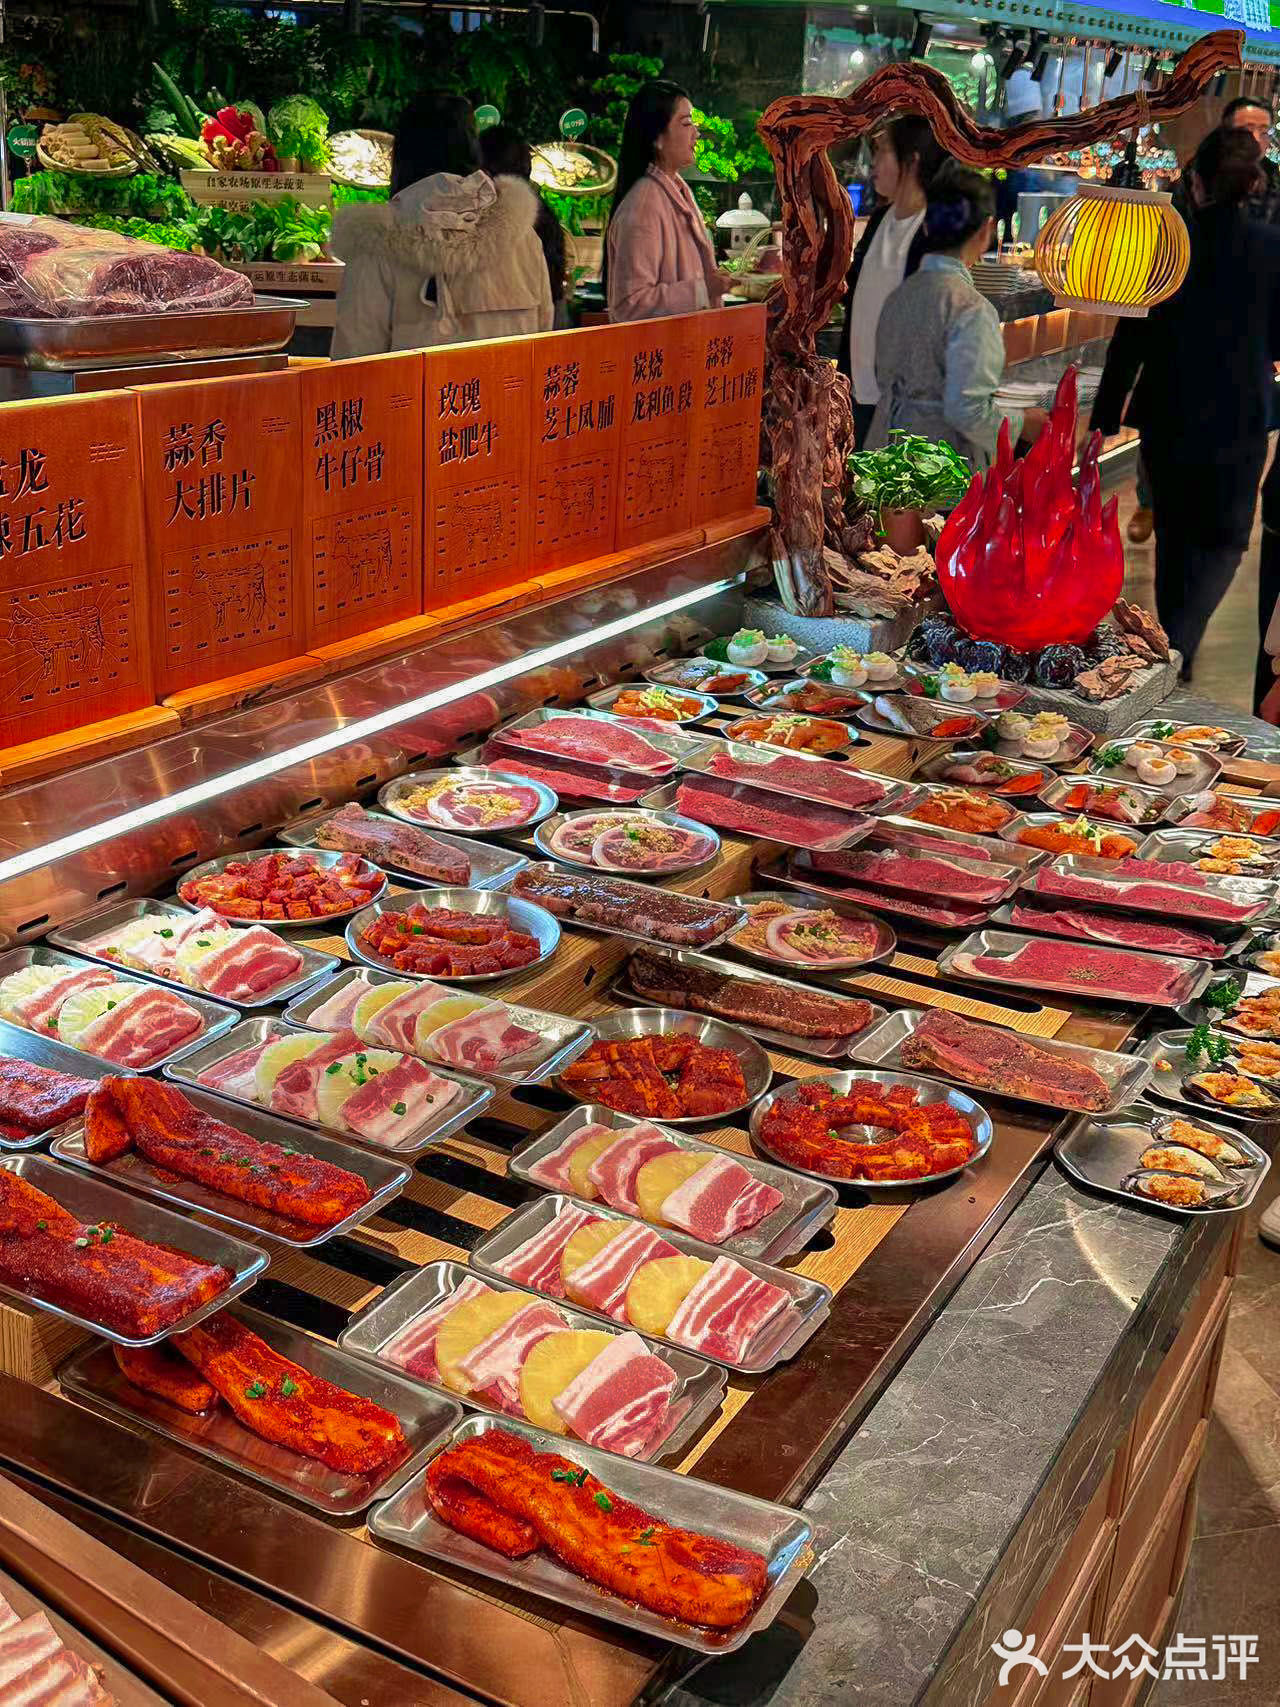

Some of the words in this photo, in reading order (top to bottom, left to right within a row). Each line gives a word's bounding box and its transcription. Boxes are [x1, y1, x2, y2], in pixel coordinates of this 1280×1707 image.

[632, 349, 664, 386] 炭烧
[705, 336, 734, 371] 蒜蓉
[438, 377, 481, 421] 玫瑰
[543, 361, 581, 402] 蒜蓉
[631, 379, 693, 425] 龙利鱼段
[160, 418, 226, 473] 蒜香
[314, 397, 364, 449] 黑椒
[438, 420, 499, 467] 盐肥牛
[315, 440, 385, 493] 牛仔骨
[164, 468, 256, 528] 大排片
